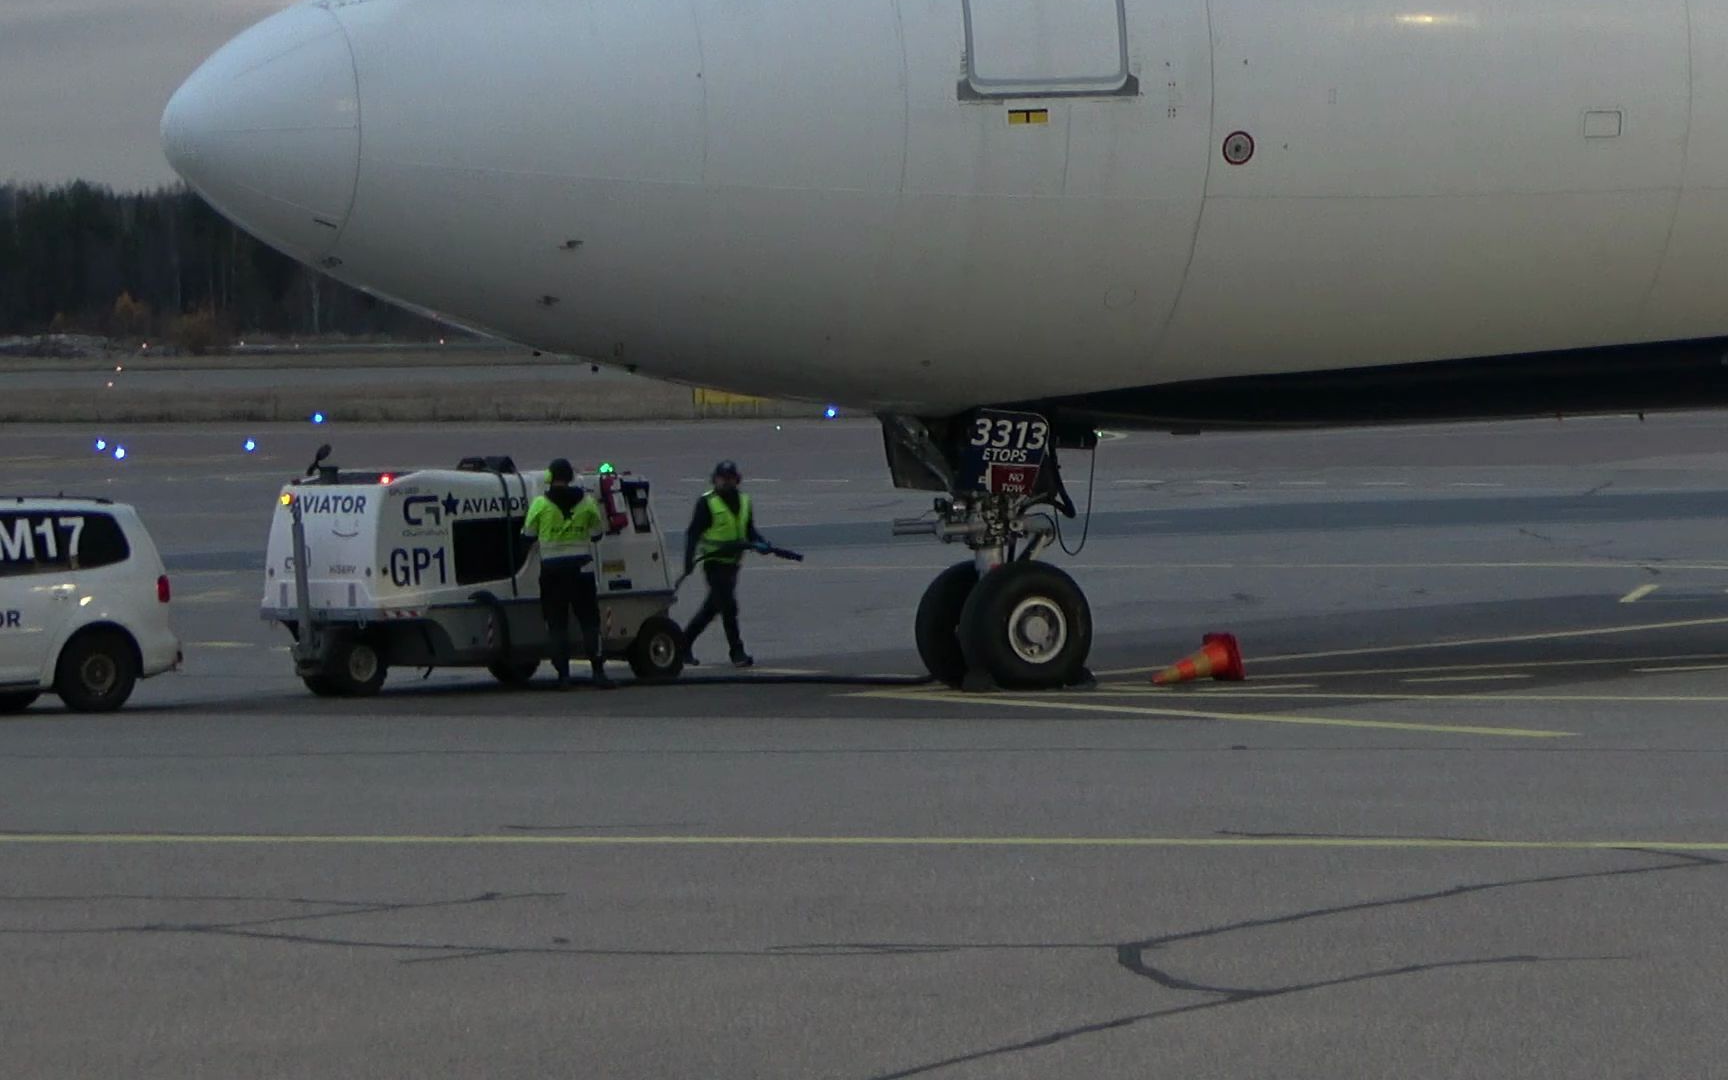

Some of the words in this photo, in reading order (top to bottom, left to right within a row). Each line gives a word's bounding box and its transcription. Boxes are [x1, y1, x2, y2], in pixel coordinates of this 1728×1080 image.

[970, 418, 1048, 450] 3313
[982, 447, 1028, 462] ETOPS
[1008, 472, 1025, 482] NO
[291, 494, 367, 514] AVIATOR
[0, 516, 85, 560] M17
[390, 546, 446, 587] GP1
